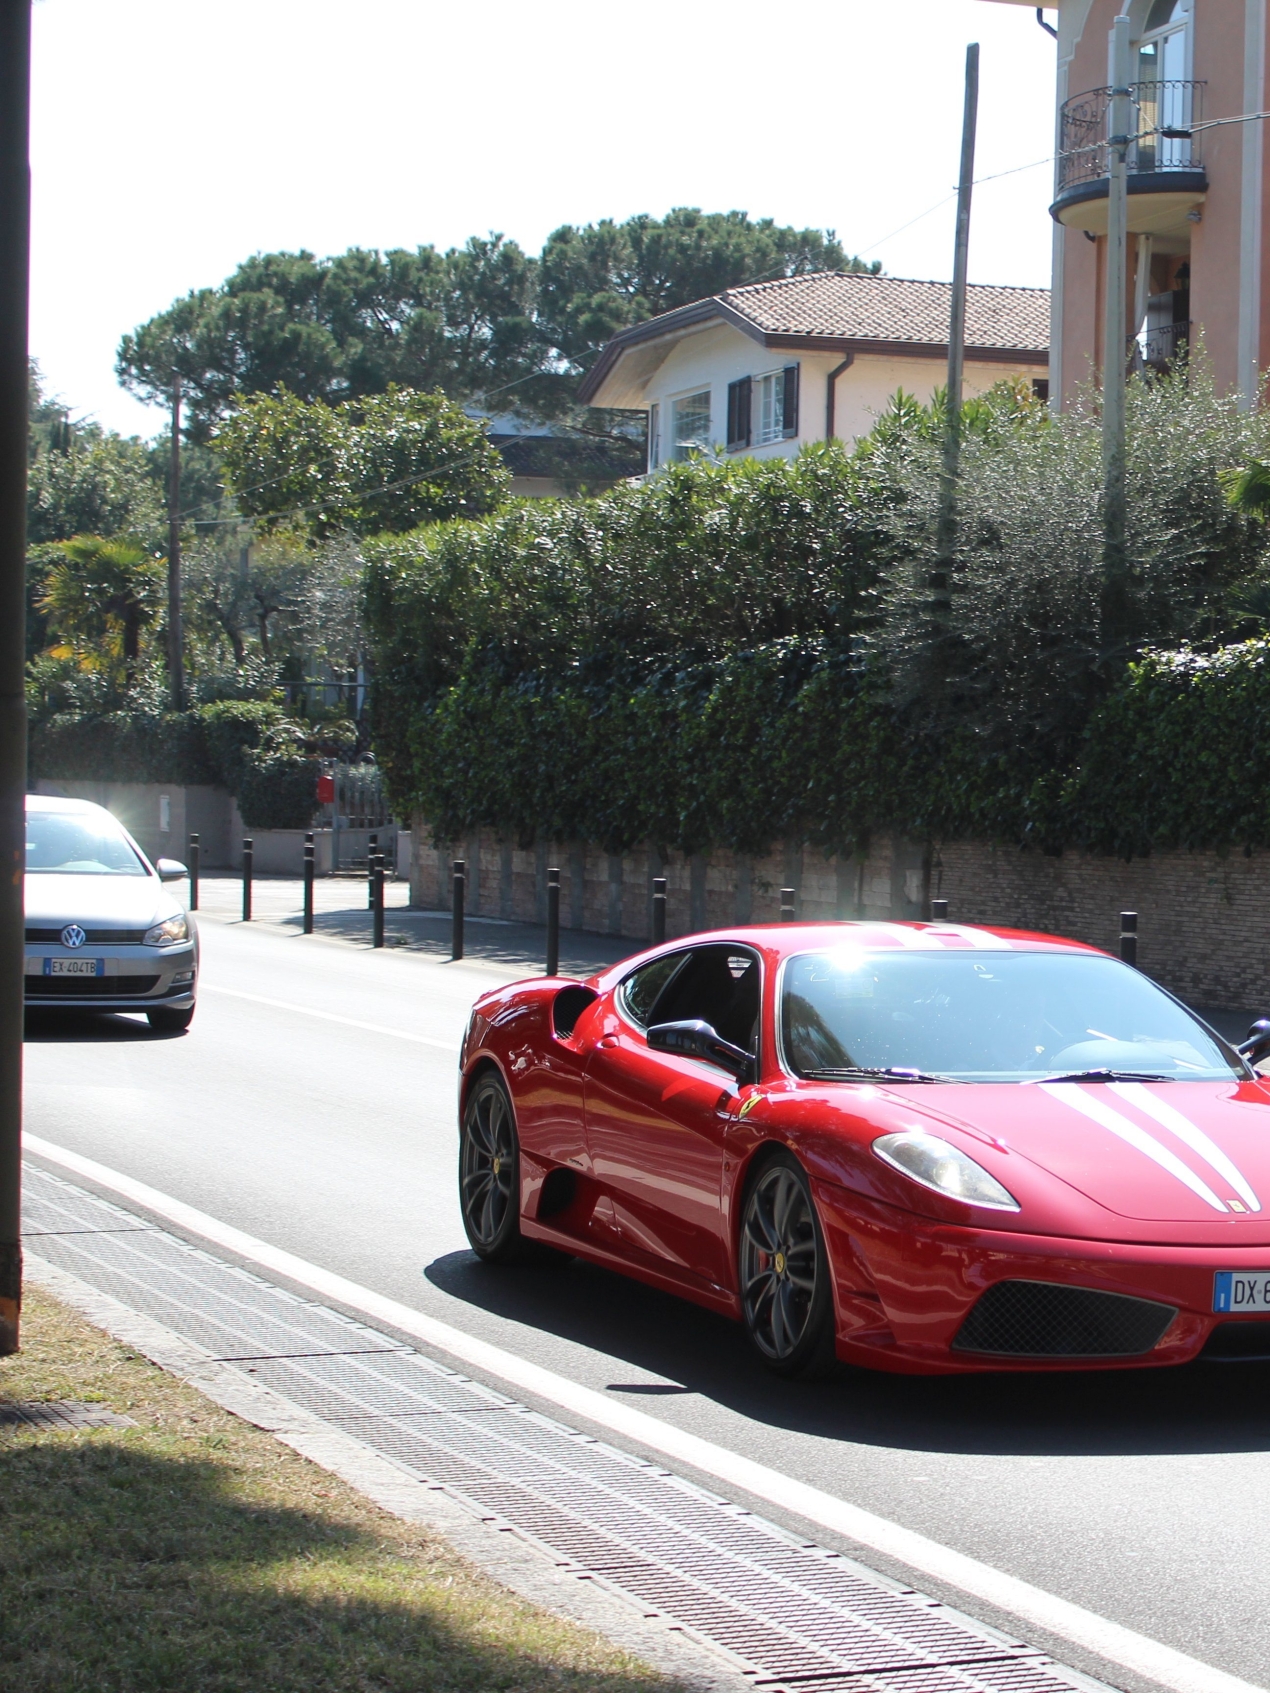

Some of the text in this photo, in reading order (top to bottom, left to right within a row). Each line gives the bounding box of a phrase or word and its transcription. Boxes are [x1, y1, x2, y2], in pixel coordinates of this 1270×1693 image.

[52, 961, 97, 973] EX 404TB
[1233, 1280, 1257, 1305] DX
